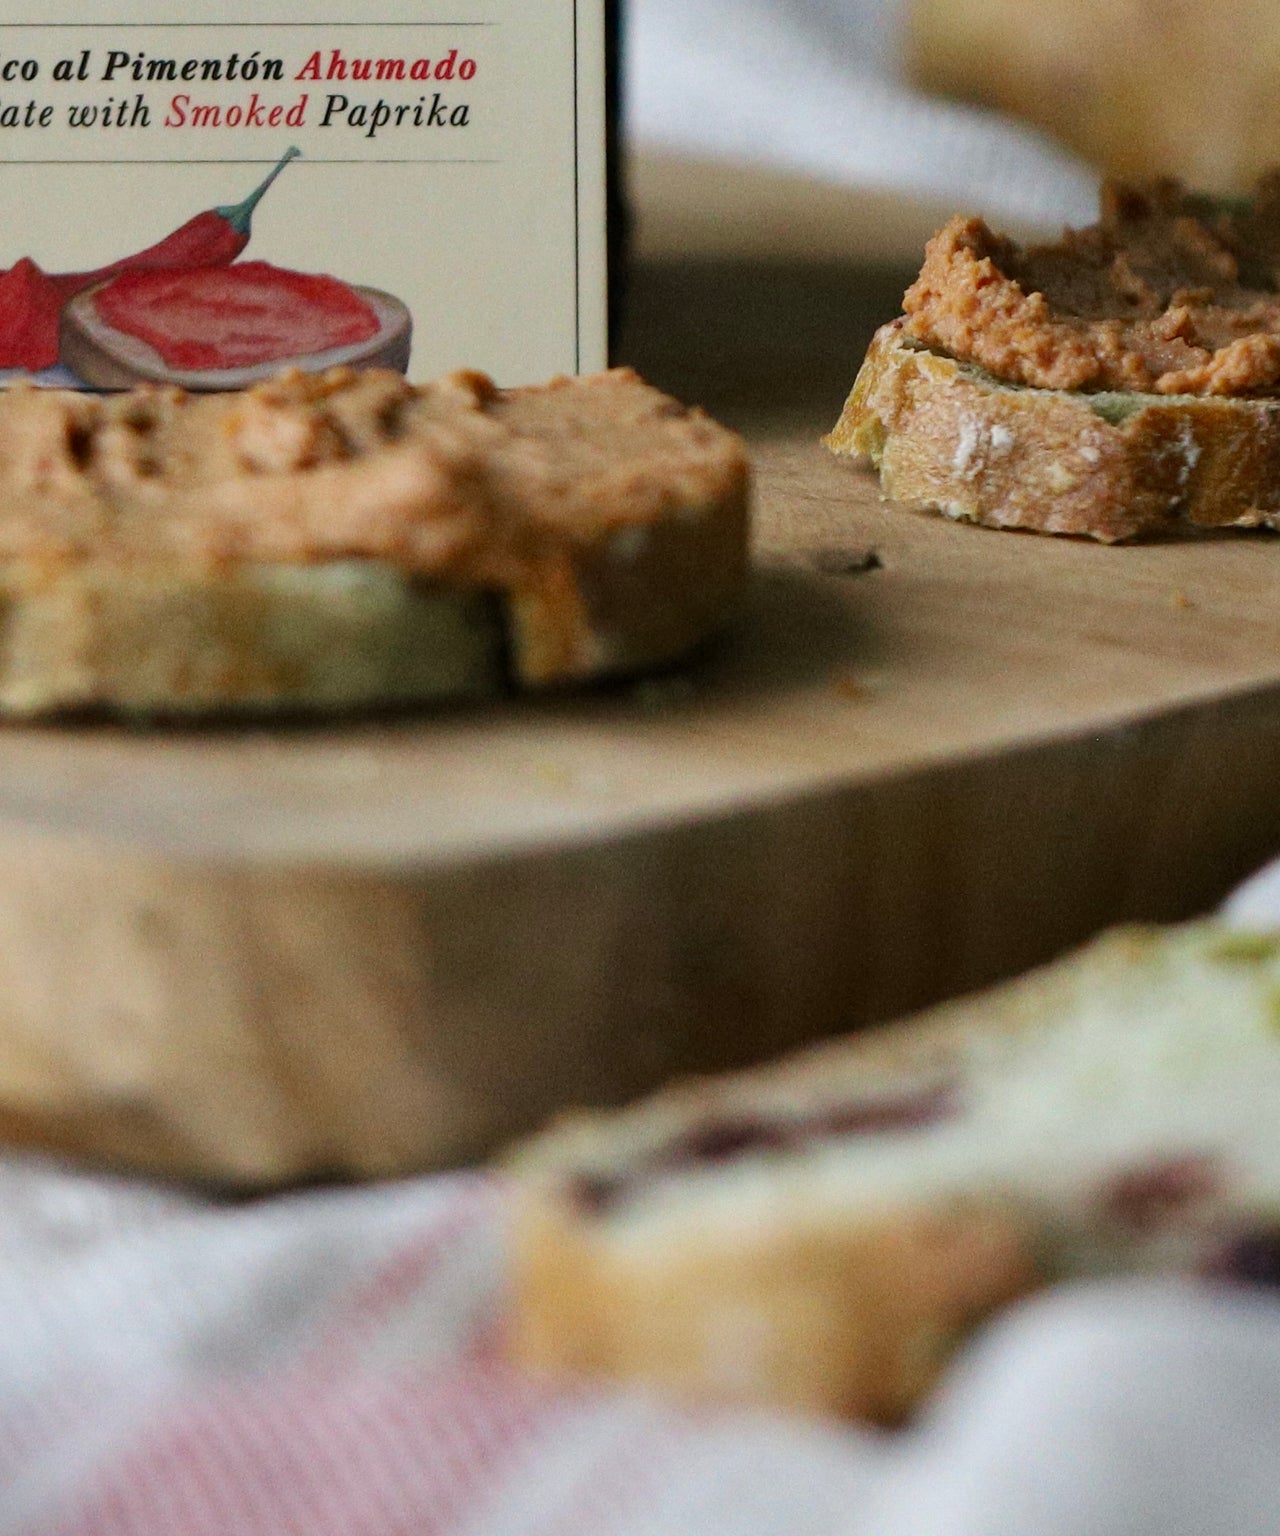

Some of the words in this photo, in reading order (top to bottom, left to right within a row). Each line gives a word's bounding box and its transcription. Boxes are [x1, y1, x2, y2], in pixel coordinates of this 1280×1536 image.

[51, 50, 90, 82] al
[100, 50, 285, 82] Pimentón
[293, 49, 478, 82] Ahumado
[67, 95, 152, 128] with
[164, 95, 306, 129] Smoked
[317, 95, 470, 138] Paprika
